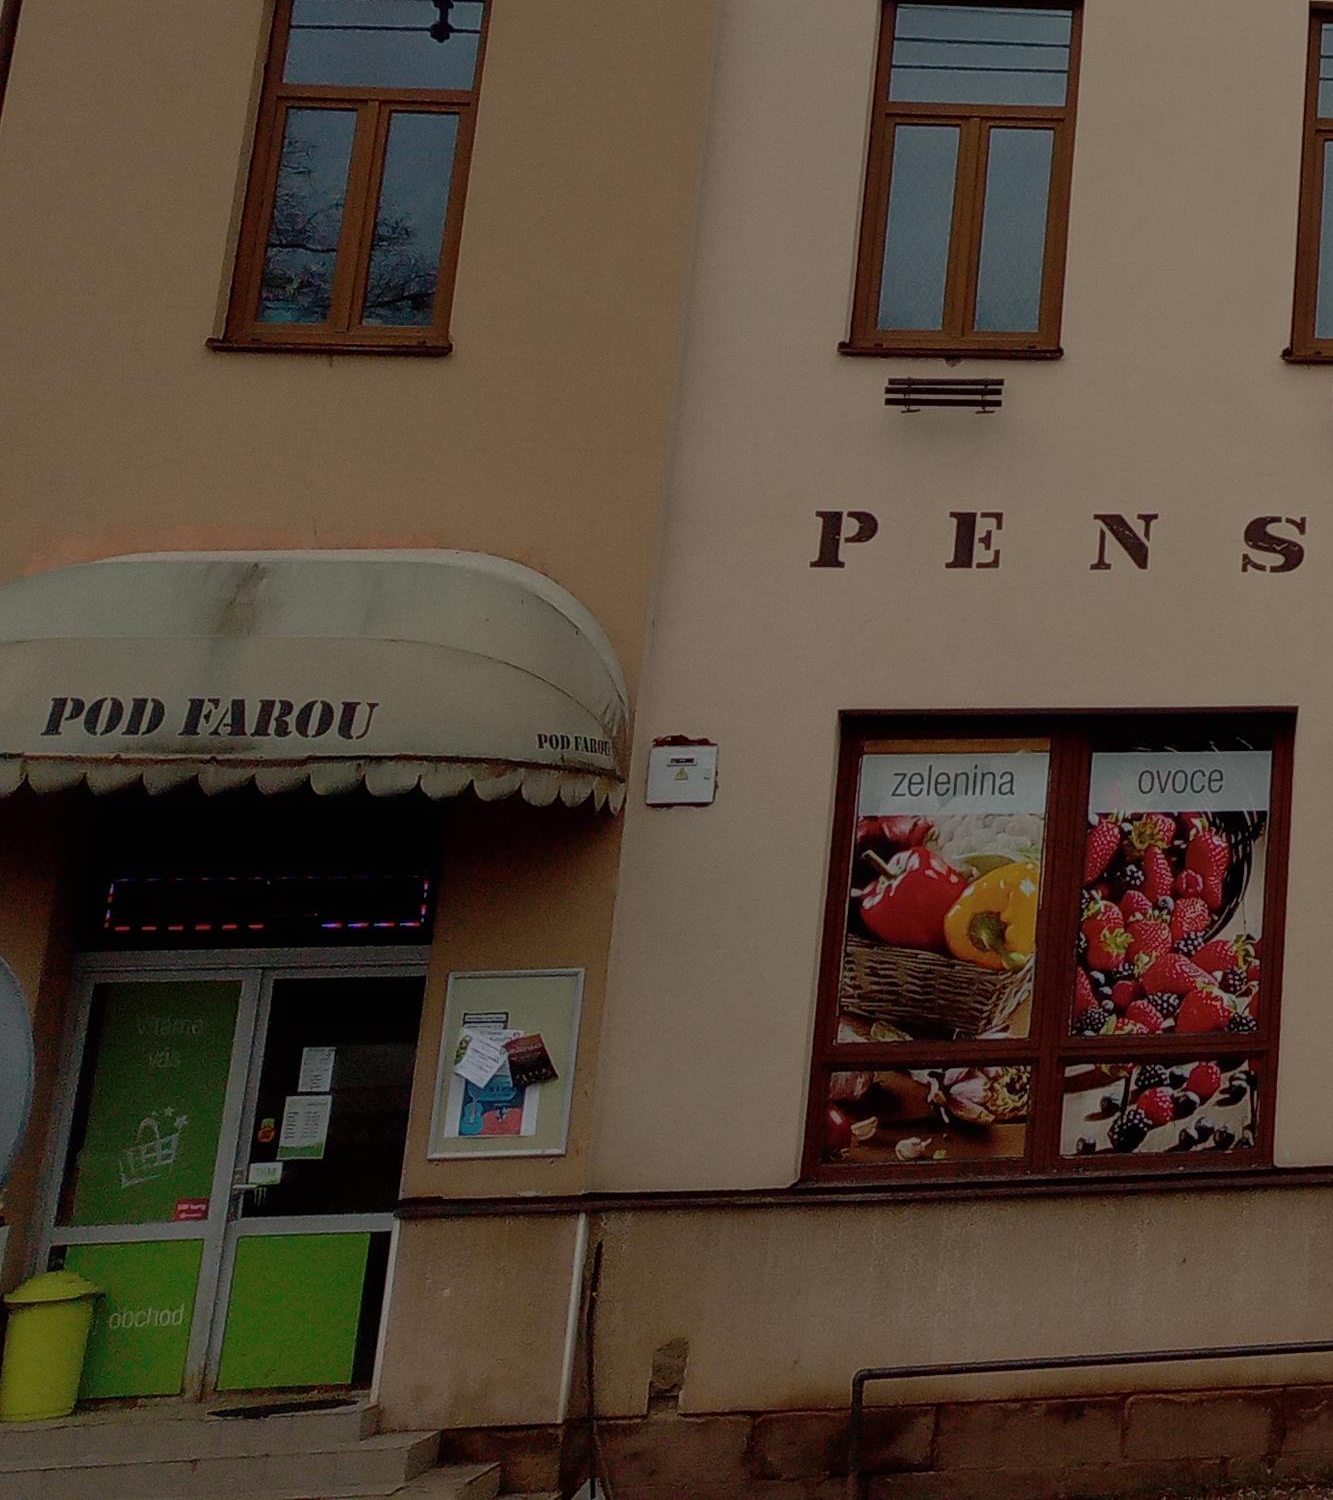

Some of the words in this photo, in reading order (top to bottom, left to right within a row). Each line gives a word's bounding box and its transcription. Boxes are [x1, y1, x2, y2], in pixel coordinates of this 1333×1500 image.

[40, 697, 165, 736] POD
[178, 698, 379, 740] FAROU
[537, 733, 570, 750] POD
[574, 736, 610, 756] FAROU
[891, 764, 1015, 798] zelenina
[1138, 764, 1224, 796] ovoce
[109, 1303, 185, 1330] obchod
